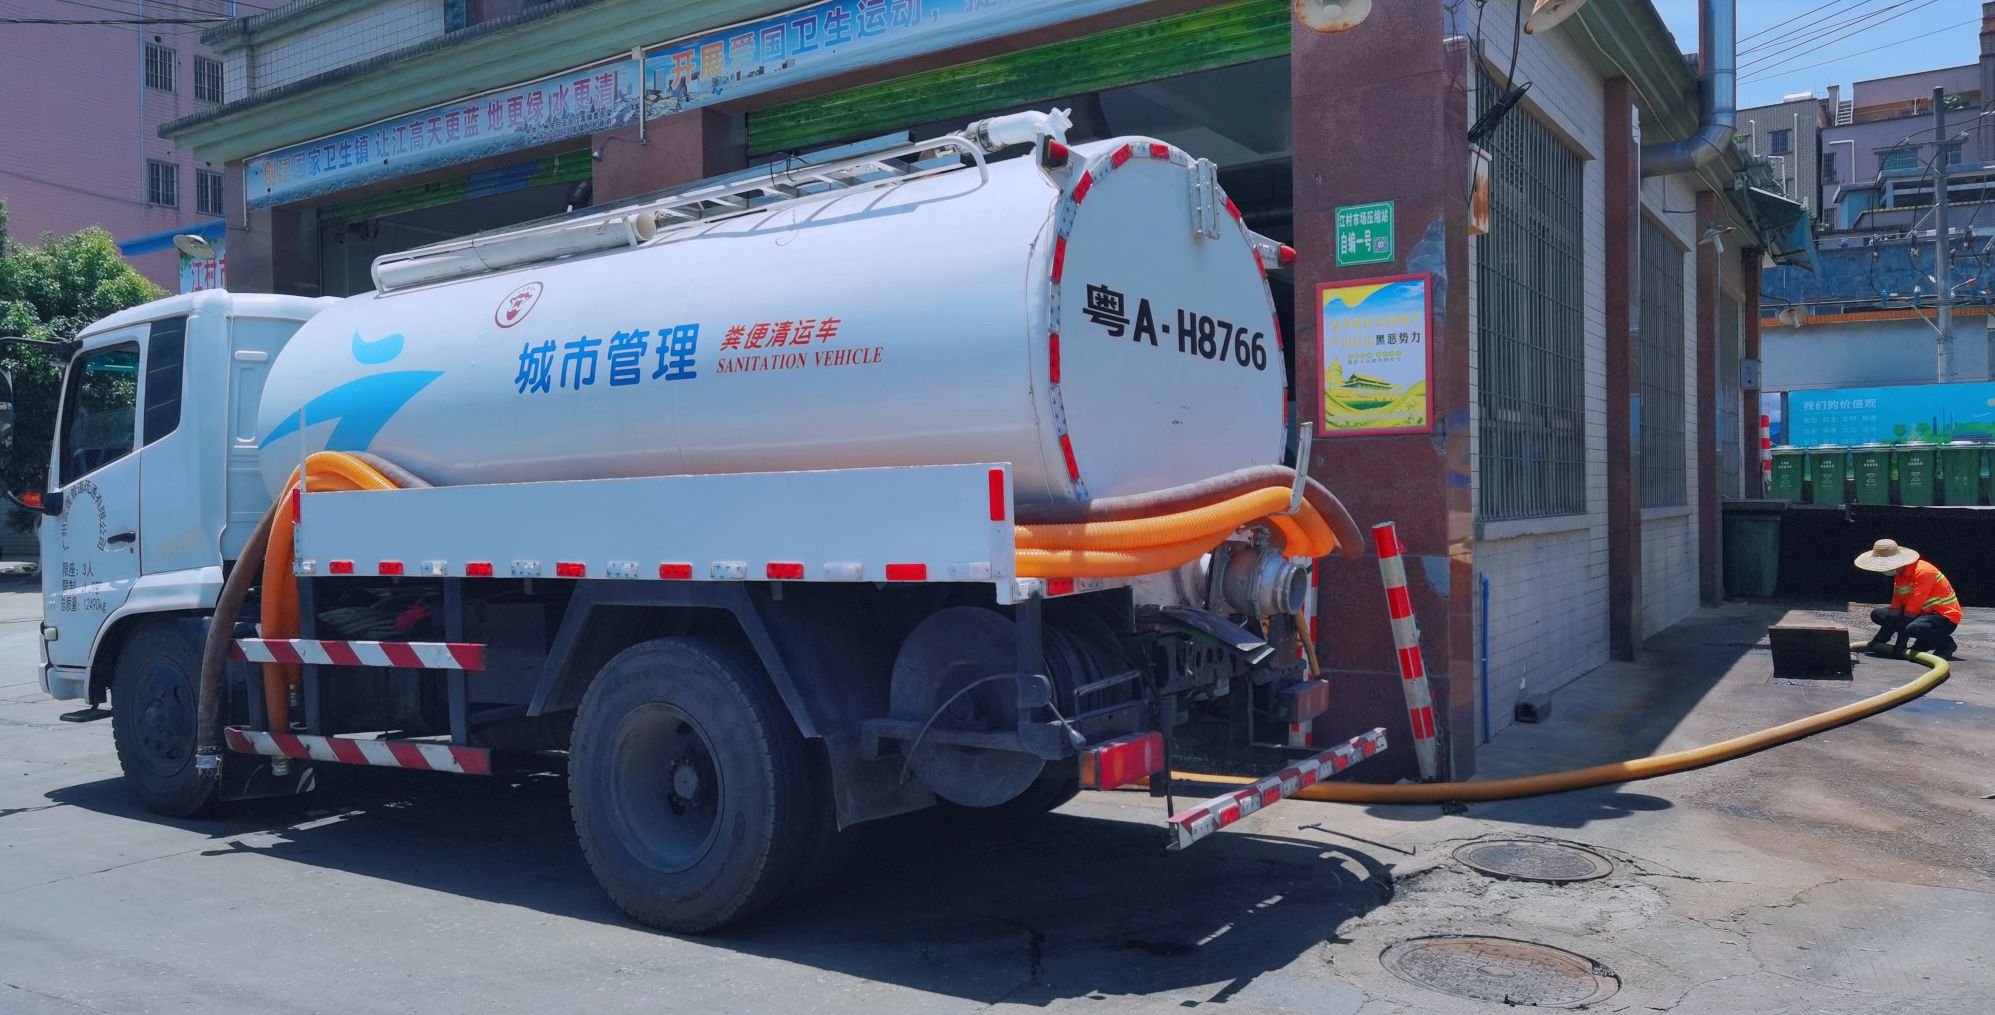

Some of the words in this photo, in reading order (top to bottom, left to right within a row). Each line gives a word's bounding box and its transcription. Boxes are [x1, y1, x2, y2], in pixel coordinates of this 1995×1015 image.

[376, 106, 480, 158] 让江高天更蓝
[488, 91, 544, 132] 地更绿
[552, 72, 615, 114] 水更清
[1339, 209, 1388, 227] 江村市场压缩站
[1341, 230, 1371, 255] 自编一号
[720, 317, 841, 351] 粪便清运车
[515, 323, 700, 394] 城市管理
[716, 352, 808, 374] SANITATION
[814, 346, 884, 368] VEHICLE
[1803, 398, 1877, 411] 我们的价值观
